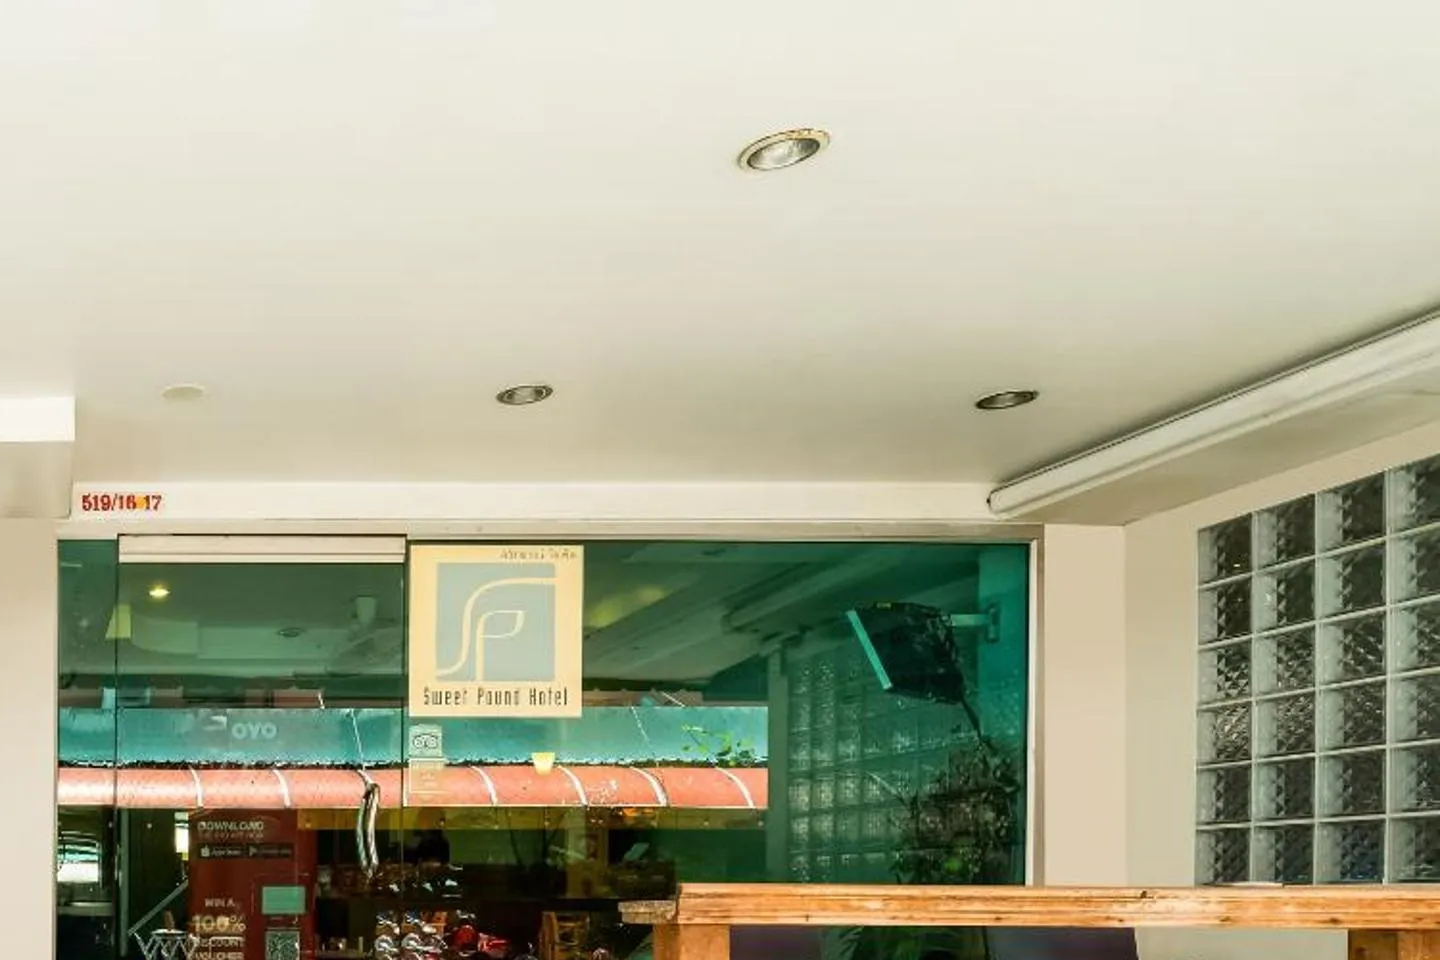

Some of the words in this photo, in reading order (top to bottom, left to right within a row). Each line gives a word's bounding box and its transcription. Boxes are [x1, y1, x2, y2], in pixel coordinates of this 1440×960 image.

[423, 687, 468, 706] Sweet
[477, 688, 520, 706] Pound
[529, 687, 568, 706] Hotel
